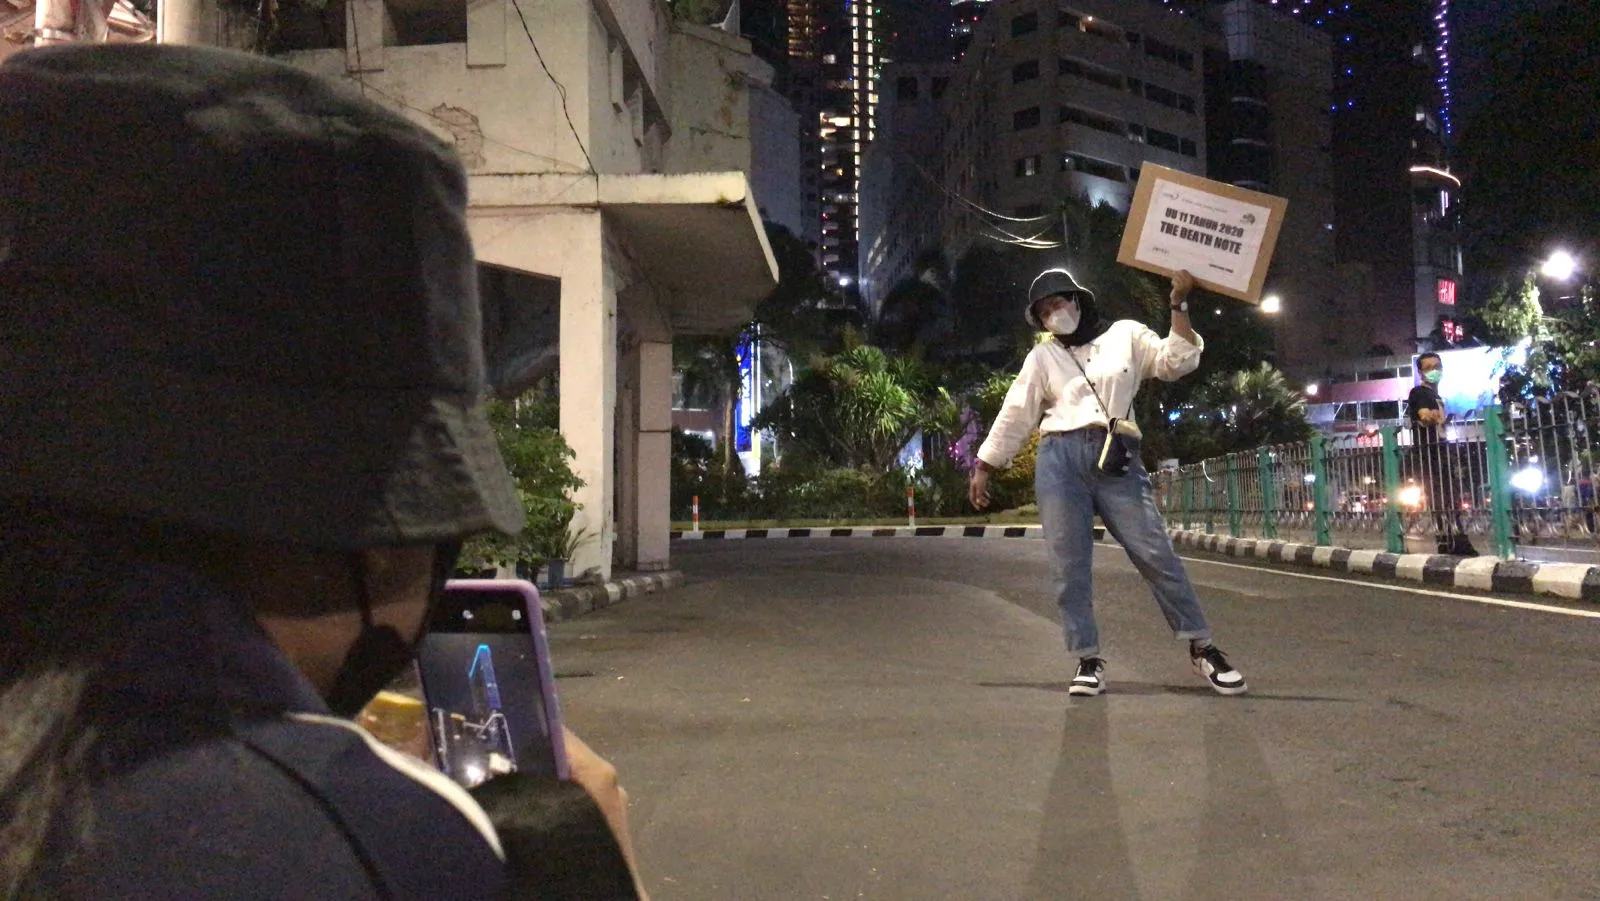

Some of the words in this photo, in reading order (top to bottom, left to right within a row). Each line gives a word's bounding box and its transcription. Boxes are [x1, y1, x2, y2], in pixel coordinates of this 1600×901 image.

[1160, 221, 1181, 236] THE
[1180, 226, 1213, 246] DEATH
[1214, 236, 1242, 255] NOTE
[1165, 207, 1178, 219] UU
[1179, 212, 1188, 222] 11
[1189, 215, 1218, 231] TAHUN
[1219, 223, 1244, 238] 2020
